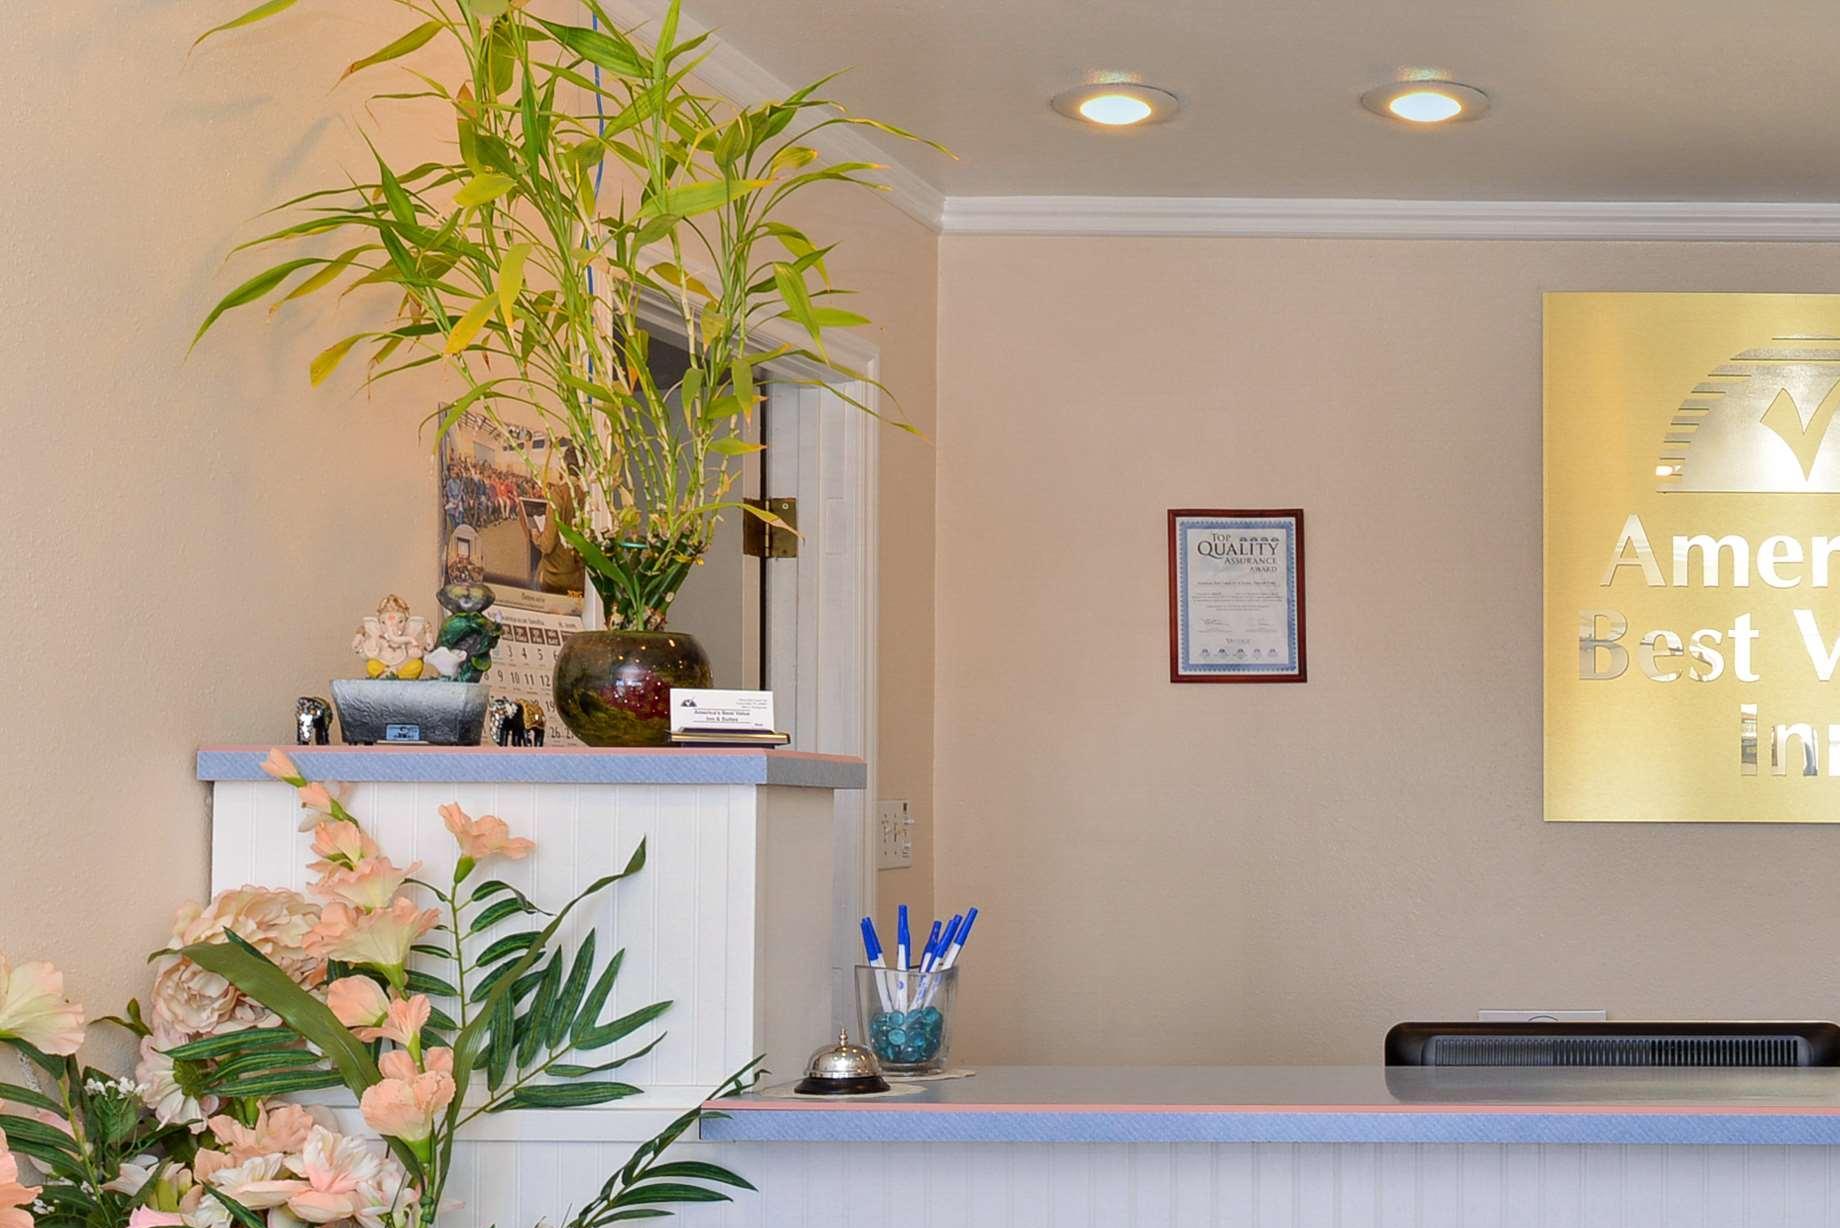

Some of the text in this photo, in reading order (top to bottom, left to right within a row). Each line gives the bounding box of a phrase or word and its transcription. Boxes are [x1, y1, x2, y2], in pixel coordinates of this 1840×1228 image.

[1197, 540, 1279, 560] QUALITY
[1224, 557, 1278, 565] ASSURANCE
[1578, 608, 1761, 684] Best
